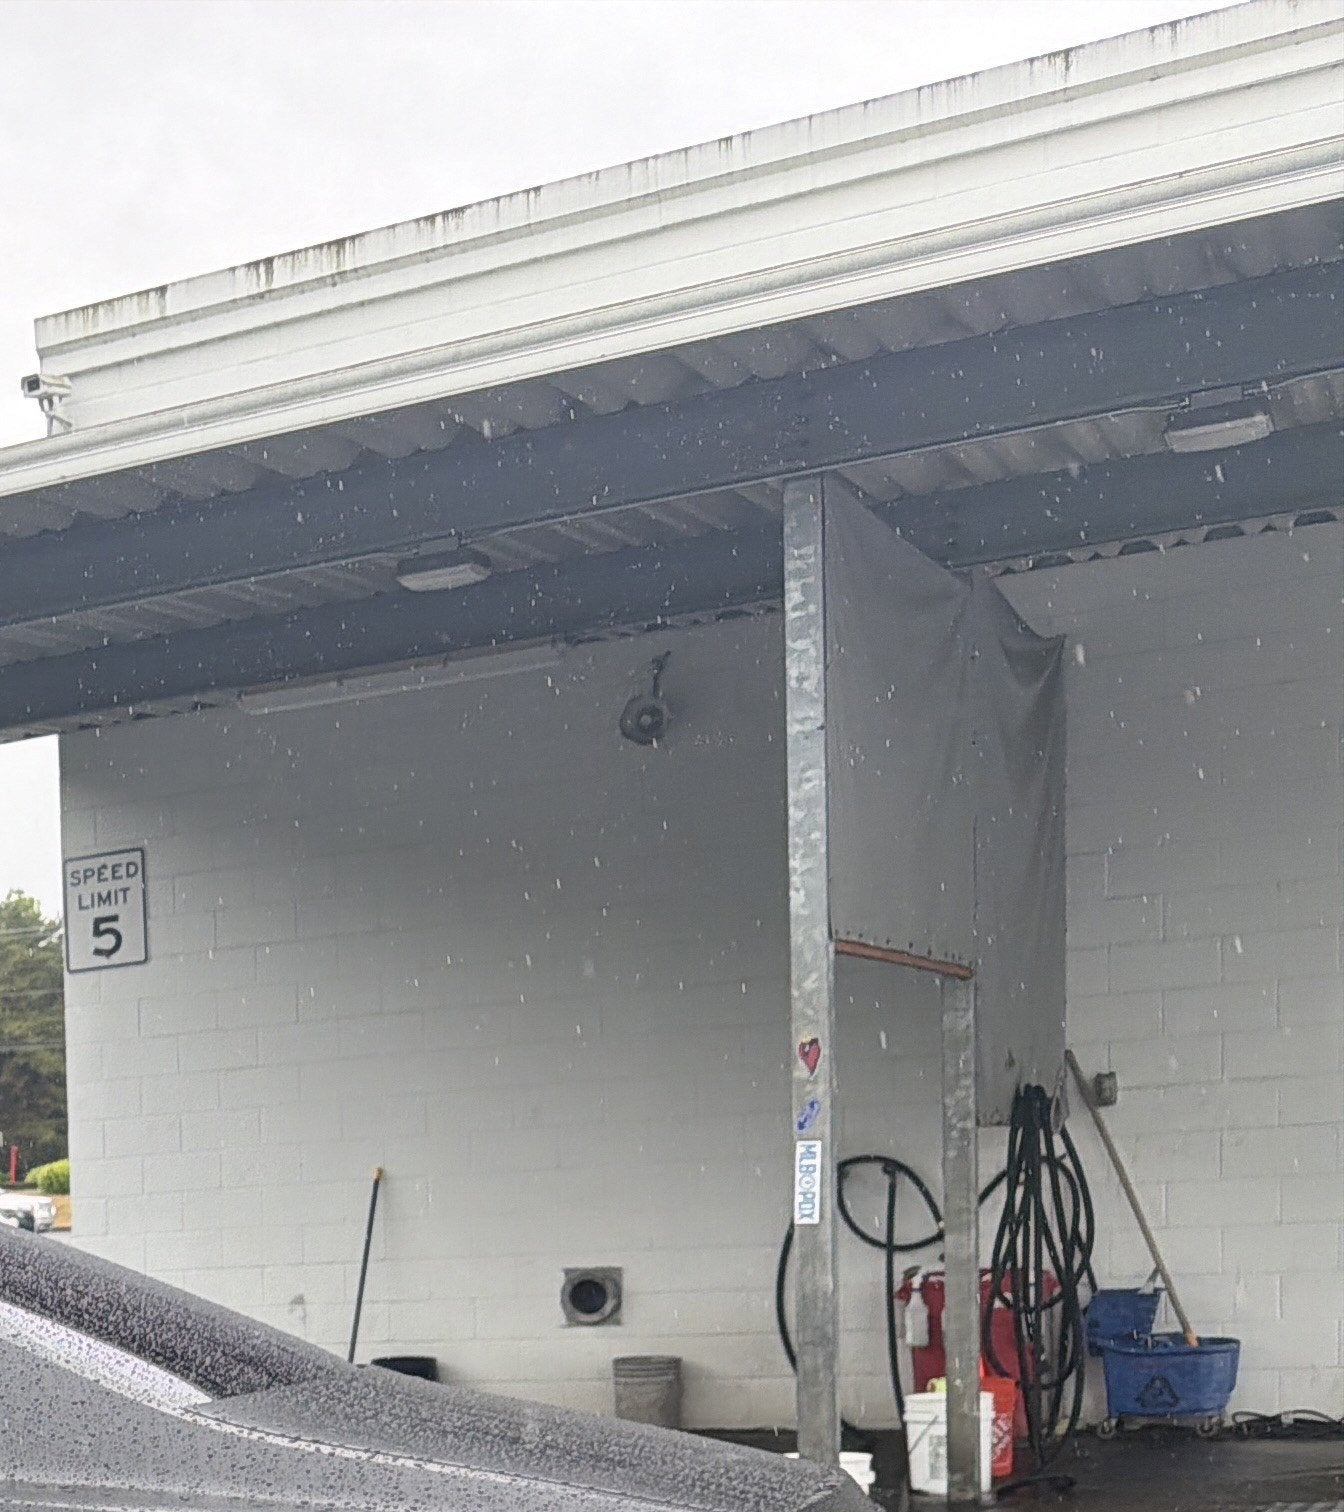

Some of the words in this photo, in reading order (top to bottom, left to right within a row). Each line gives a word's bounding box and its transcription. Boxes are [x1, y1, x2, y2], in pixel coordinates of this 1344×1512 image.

[69, 861, 140, 887] SPEED
[77, 887, 131, 911] LIMIT
[92, 915, 123, 958] 5
